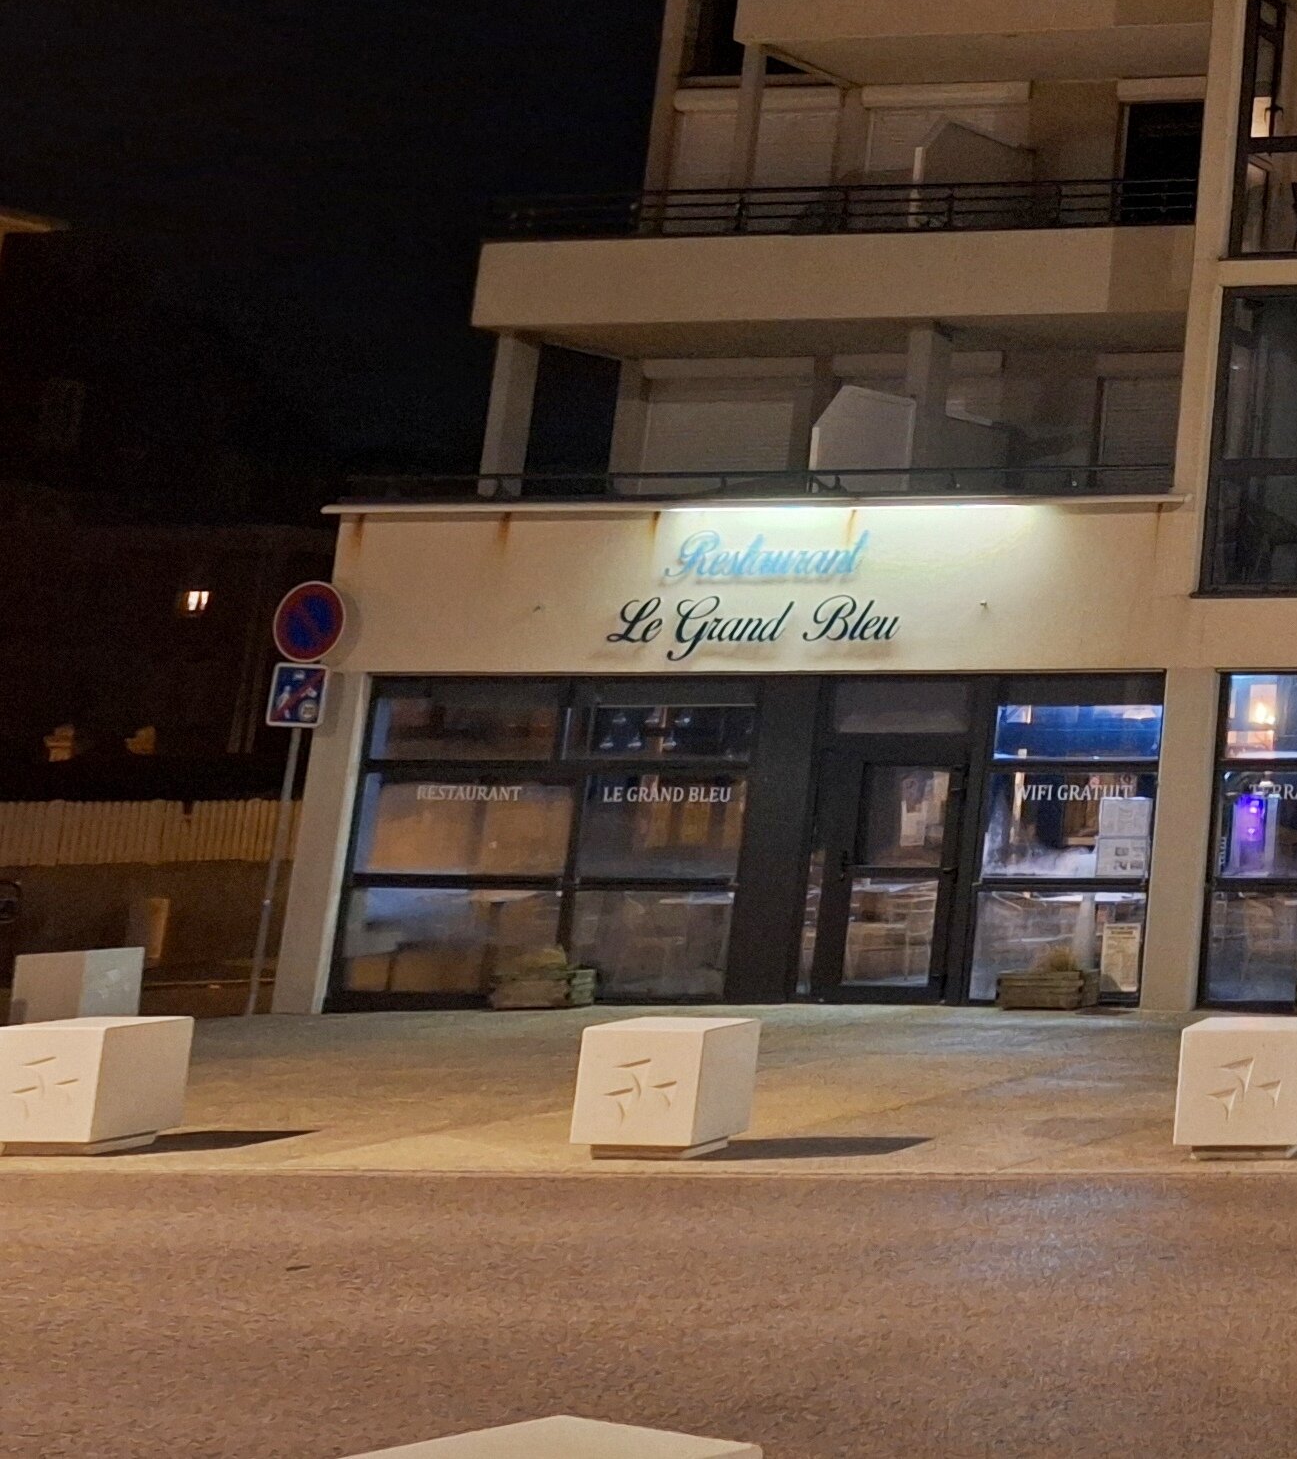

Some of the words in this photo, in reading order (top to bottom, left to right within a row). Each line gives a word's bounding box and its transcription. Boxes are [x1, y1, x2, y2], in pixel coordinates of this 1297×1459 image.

[664, 529, 870, 578] Restaurant
[606, 596, 663, 644] Le
[666, 595, 795, 661] Grand
[802, 594, 900, 642] Bleu
[415, 784, 523, 802] RESTAURANT
[602, 786, 623, 803] LE
[626, 786, 684, 803] GRAND
[687, 786, 732, 804] BLEU
[1056, 784, 1132, 802] GRATUIT
